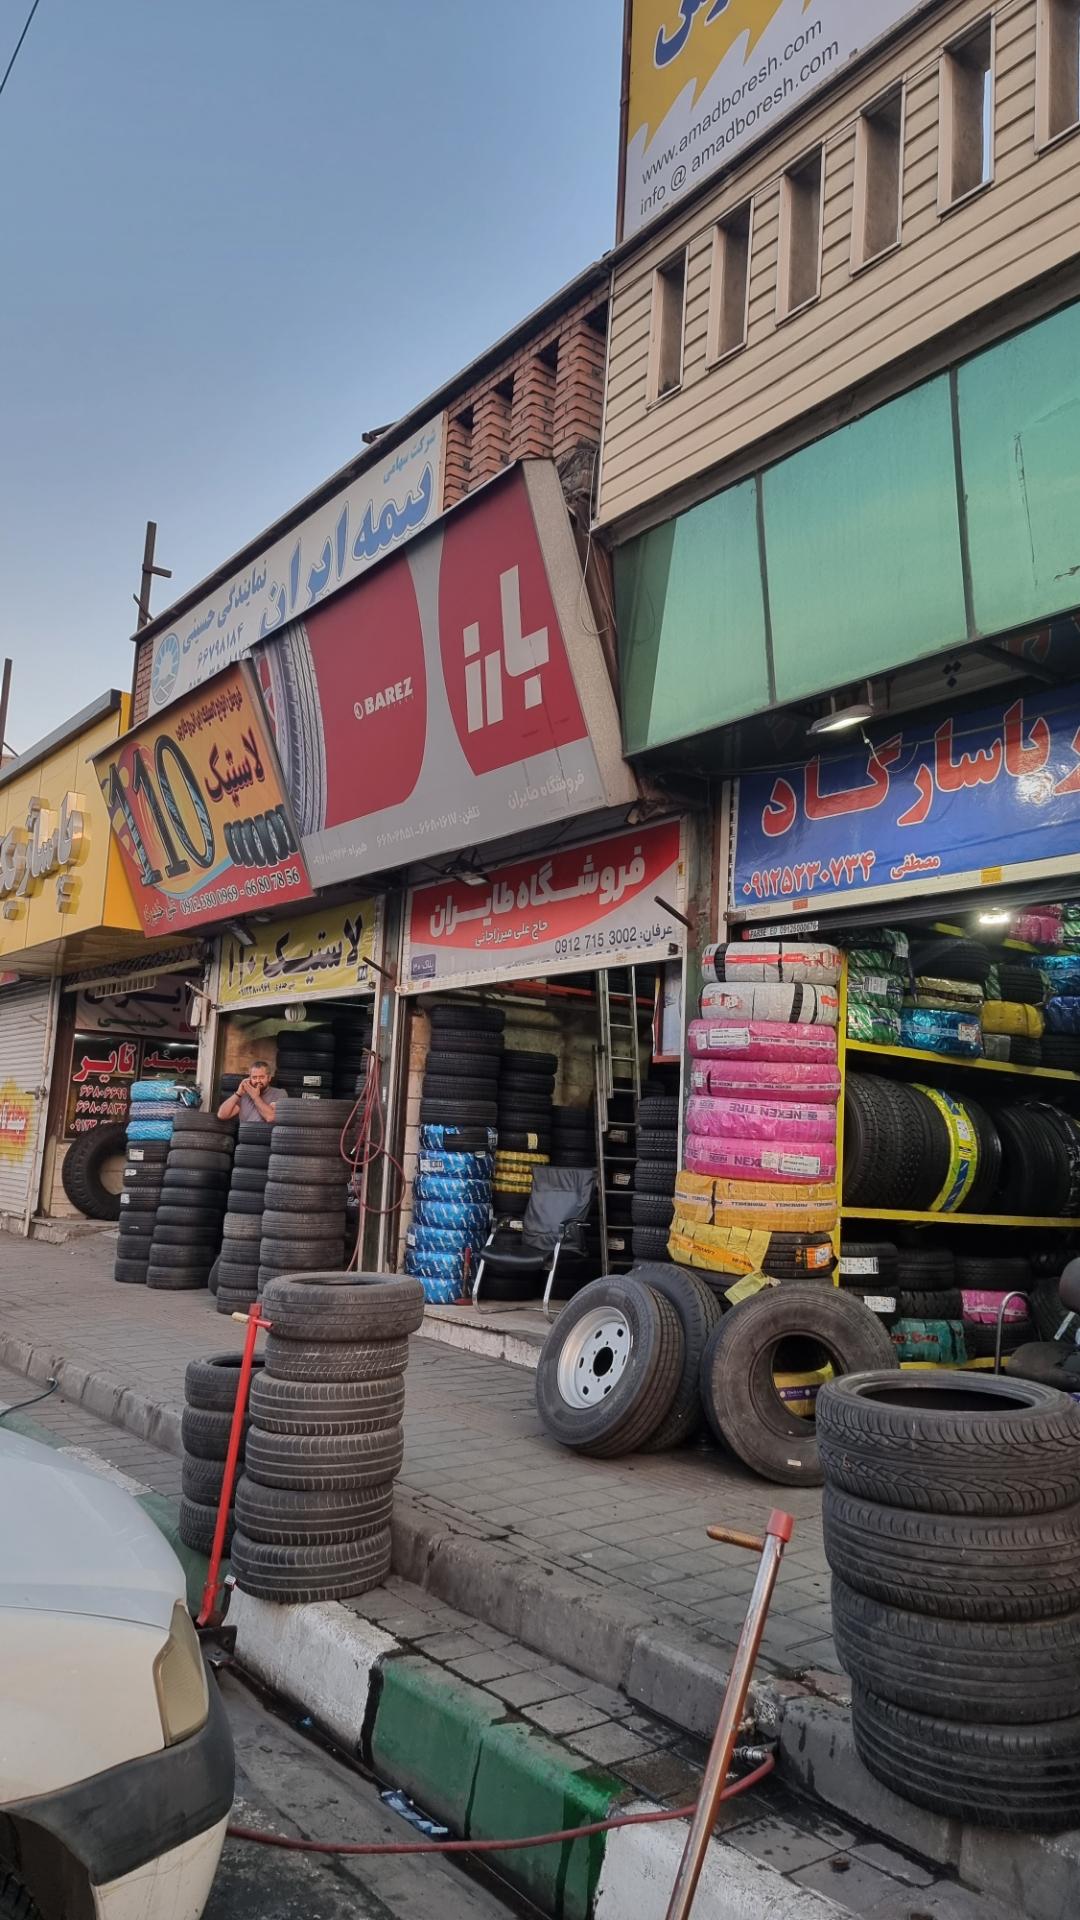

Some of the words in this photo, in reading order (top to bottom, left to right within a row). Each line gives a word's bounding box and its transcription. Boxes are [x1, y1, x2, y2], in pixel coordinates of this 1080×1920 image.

[640, 19, 823, 185] www.amadboresh.com
[639, 186, 667, 215] info
[670, 165, 688, 190] @
[691, 39, 840, 171] amadboresh.com
[462, 565, 549, 734] بارز
[364, 676, 413, 715] BAREZ
[204, 727, 266, 808] لاستیک
[518, 845, 647, 910] فروشگاه
[890, 853, 940, 880] مصطفی
[555, 936, 580, 954] 0912
[584, 932, 605, 949] 715
[608, 926, 637, 946] 3002
[73, 1042, 137, 1083] تایر
[729, 1102, 757, 1116] TIRE
[760, 1107, 802, 1120] NEXEN
